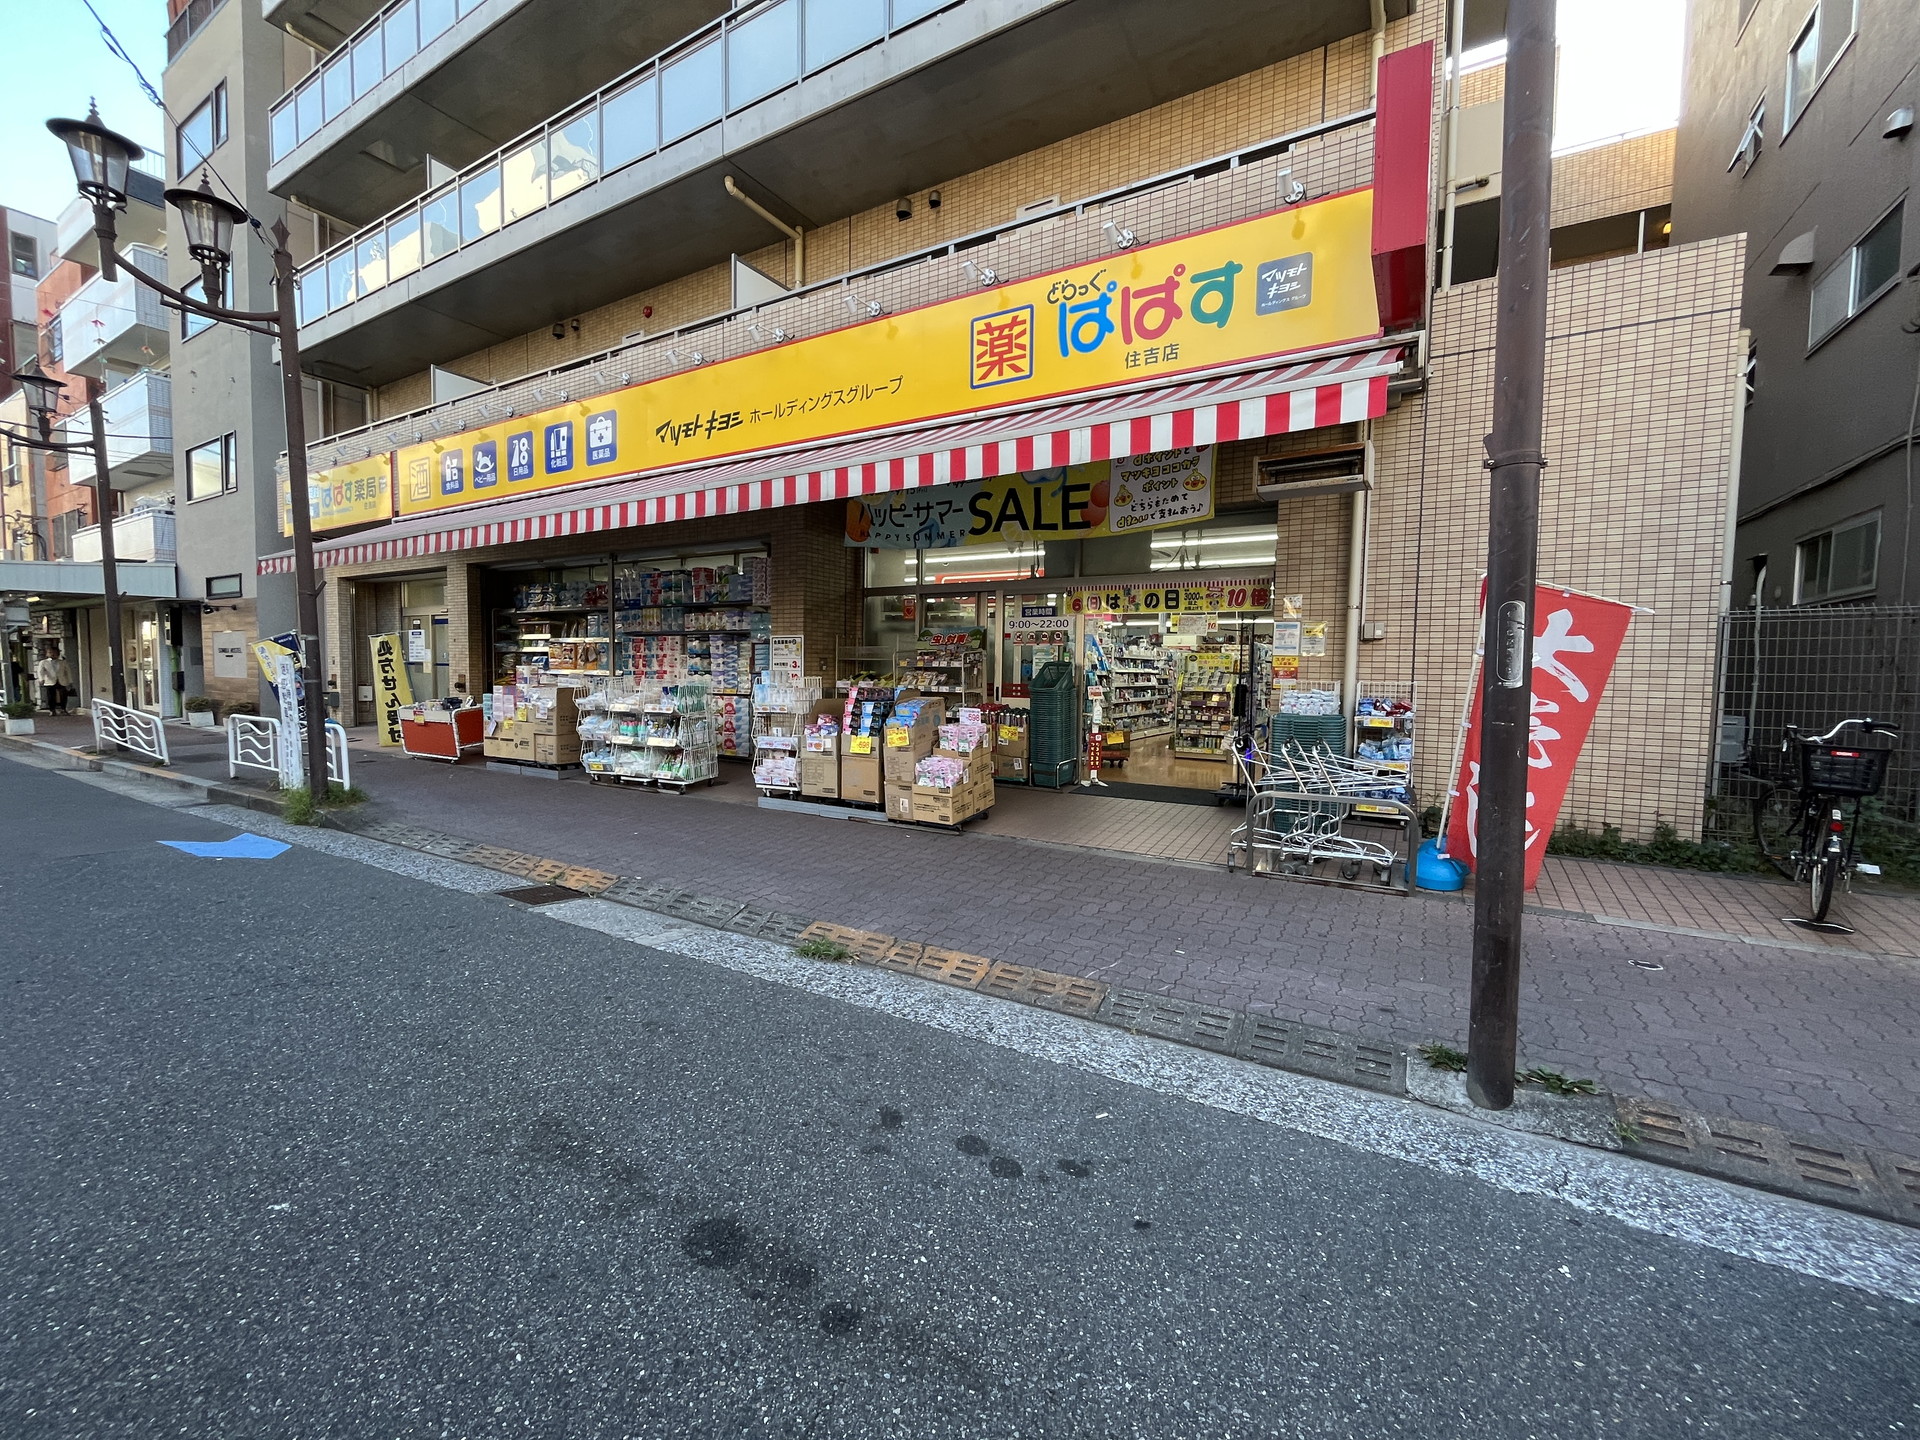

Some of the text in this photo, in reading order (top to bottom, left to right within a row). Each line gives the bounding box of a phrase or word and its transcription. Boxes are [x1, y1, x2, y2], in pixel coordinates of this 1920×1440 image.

[1261, 262, 1307, 283] マツモト
[1046, 268, 1107, 305] どらっぐ
[1267, 281, 1301, 299] キヨシ
[1058, 260, 1243, 358] ぱぱす
[976, 314, 1027, 382] 薬
[1124, 343, 1180, 370] 住吉店
[655, 374, 904, 447] マツモトキヨシ ホールディングスグループ
[550, 456, 568, 469] 化粧品
[592, 447, 611, 461] 医薬品
[474, 472, 496, 484] ベビー用品
[513, 465, 529, 477] 日用品
[1120, 455, 1201, 483] マツキヨココカラ
[411, 461, 429, 498] 酒
[445, 480, 460, 491] 食料品
[1141, 477, 1179, 493] ポイント
[967, 482, 1092, 536] SALE
[1130, 492, 1189, 512] どちらもためて
[858, 499, 964, 528] ハッピーサマー
[861, 529, 966, 542] HAPPY SUMMER
[1024, 607, 1053, 617] 営業時間
[1008, 619, 1070, 629] 9:00～22:00
